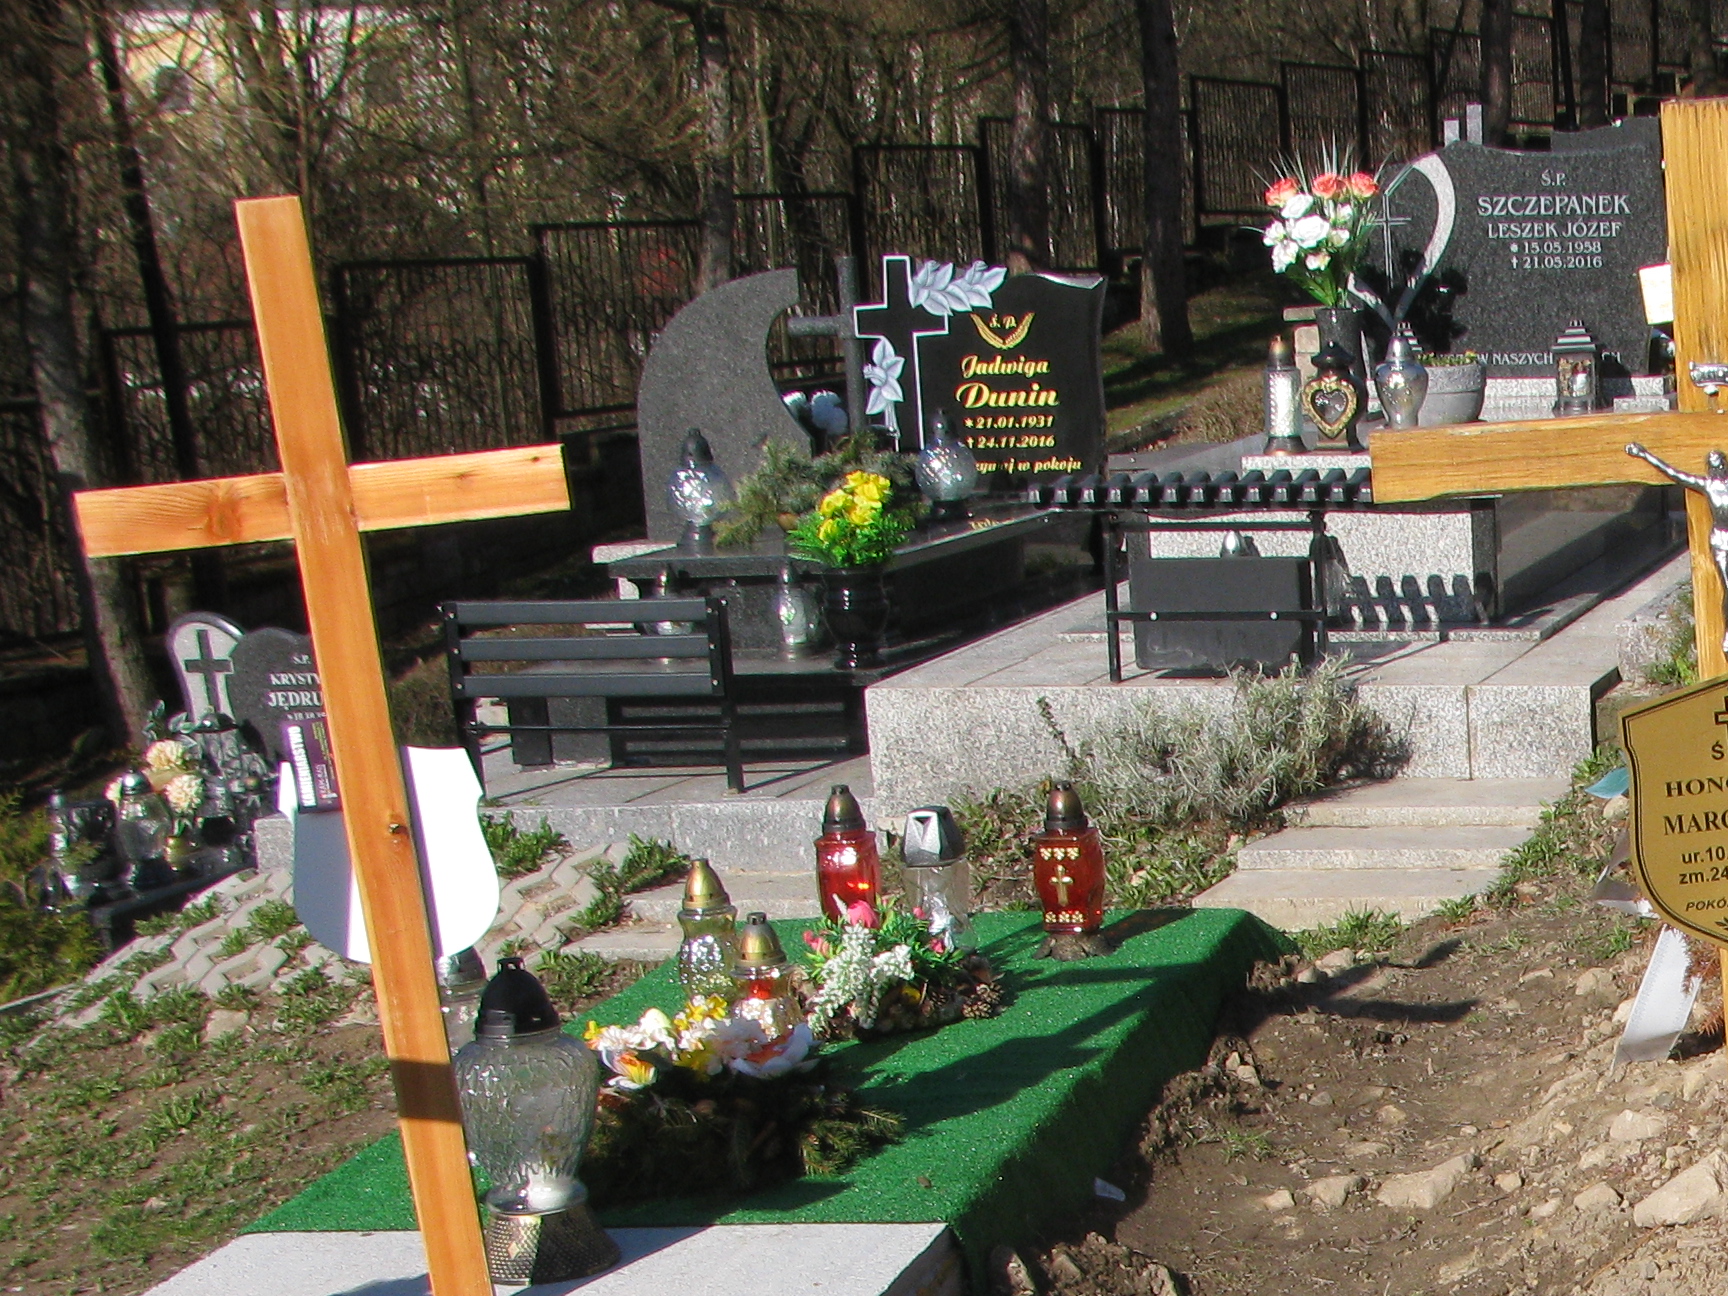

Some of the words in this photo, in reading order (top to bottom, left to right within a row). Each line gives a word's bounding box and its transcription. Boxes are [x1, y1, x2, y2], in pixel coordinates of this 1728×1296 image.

[1541, 170, 1566, 186] Ś.P.
[1477, 194, 1631, 216] SZCZEPANEK
[1488, 222, 1558, 239] LESZEK
[1562, 218, 1622, 237] JÓZEF
[1523, 242, 1601, 254] 15.05.1958
[1522, 257, 1602, 269] 21.05.2016
[961, 355, 1050, 379] Jadwiga
[1493, 352, 1553, 365] NASZYCH
[955, 382, 1060, 409] Dunin
[976, 415, 1054, 428] 21.01.1931
[978, 435, 1055, 448] 24.11.2016
[1034, 456, 1082, 474] pokoju
[1711, 740, 1724, 760] Ś
[287, 726, 317, 807] KAMIENIARSTWO
